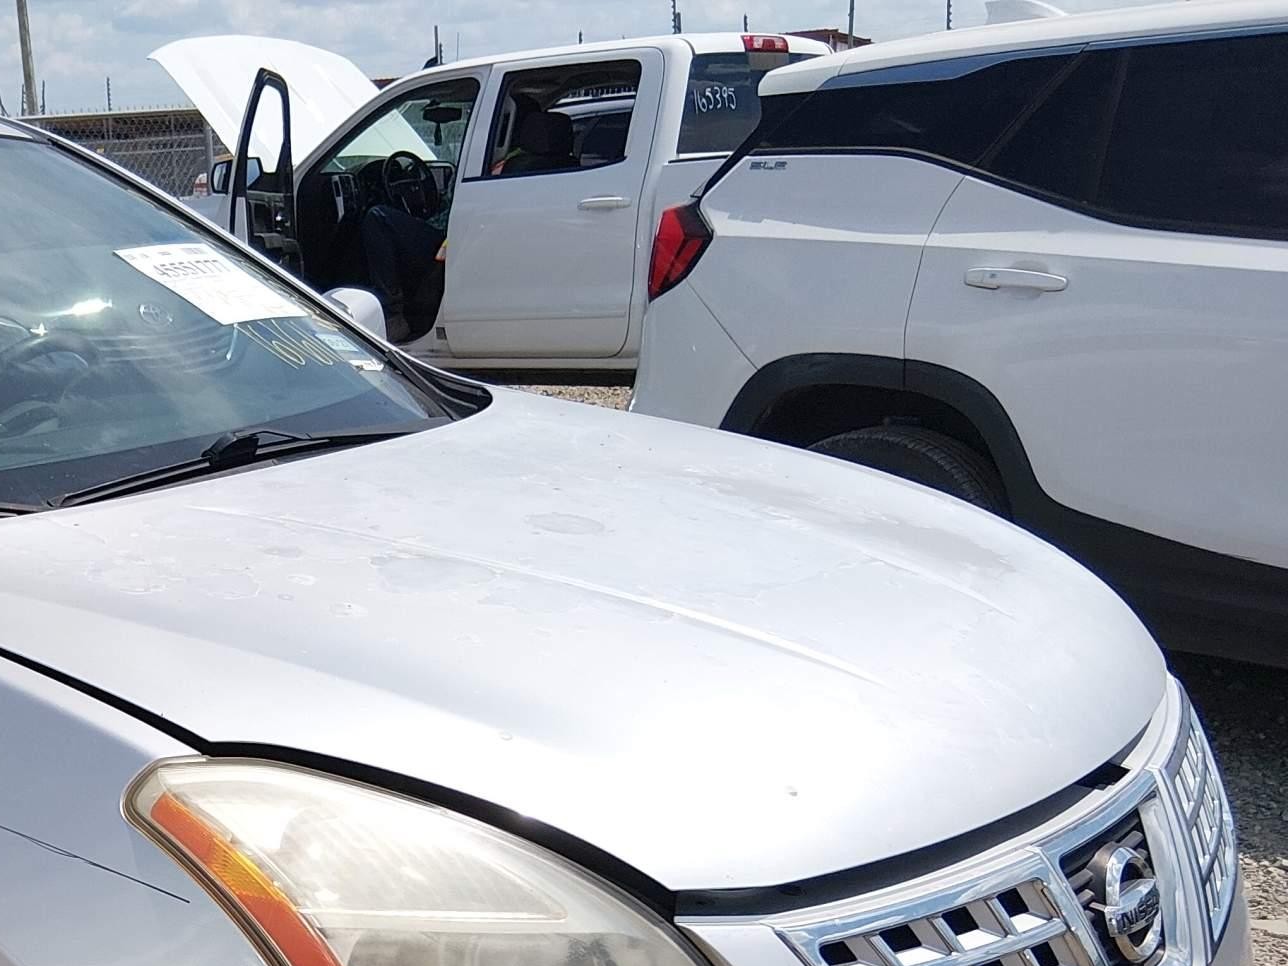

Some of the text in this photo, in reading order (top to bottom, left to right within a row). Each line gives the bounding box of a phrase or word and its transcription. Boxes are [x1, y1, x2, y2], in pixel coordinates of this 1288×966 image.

[693, 86, 737, 115] 165395
[153, 259, 232, 278] 45551777
[1120, 894, 1160, 930] NISS
